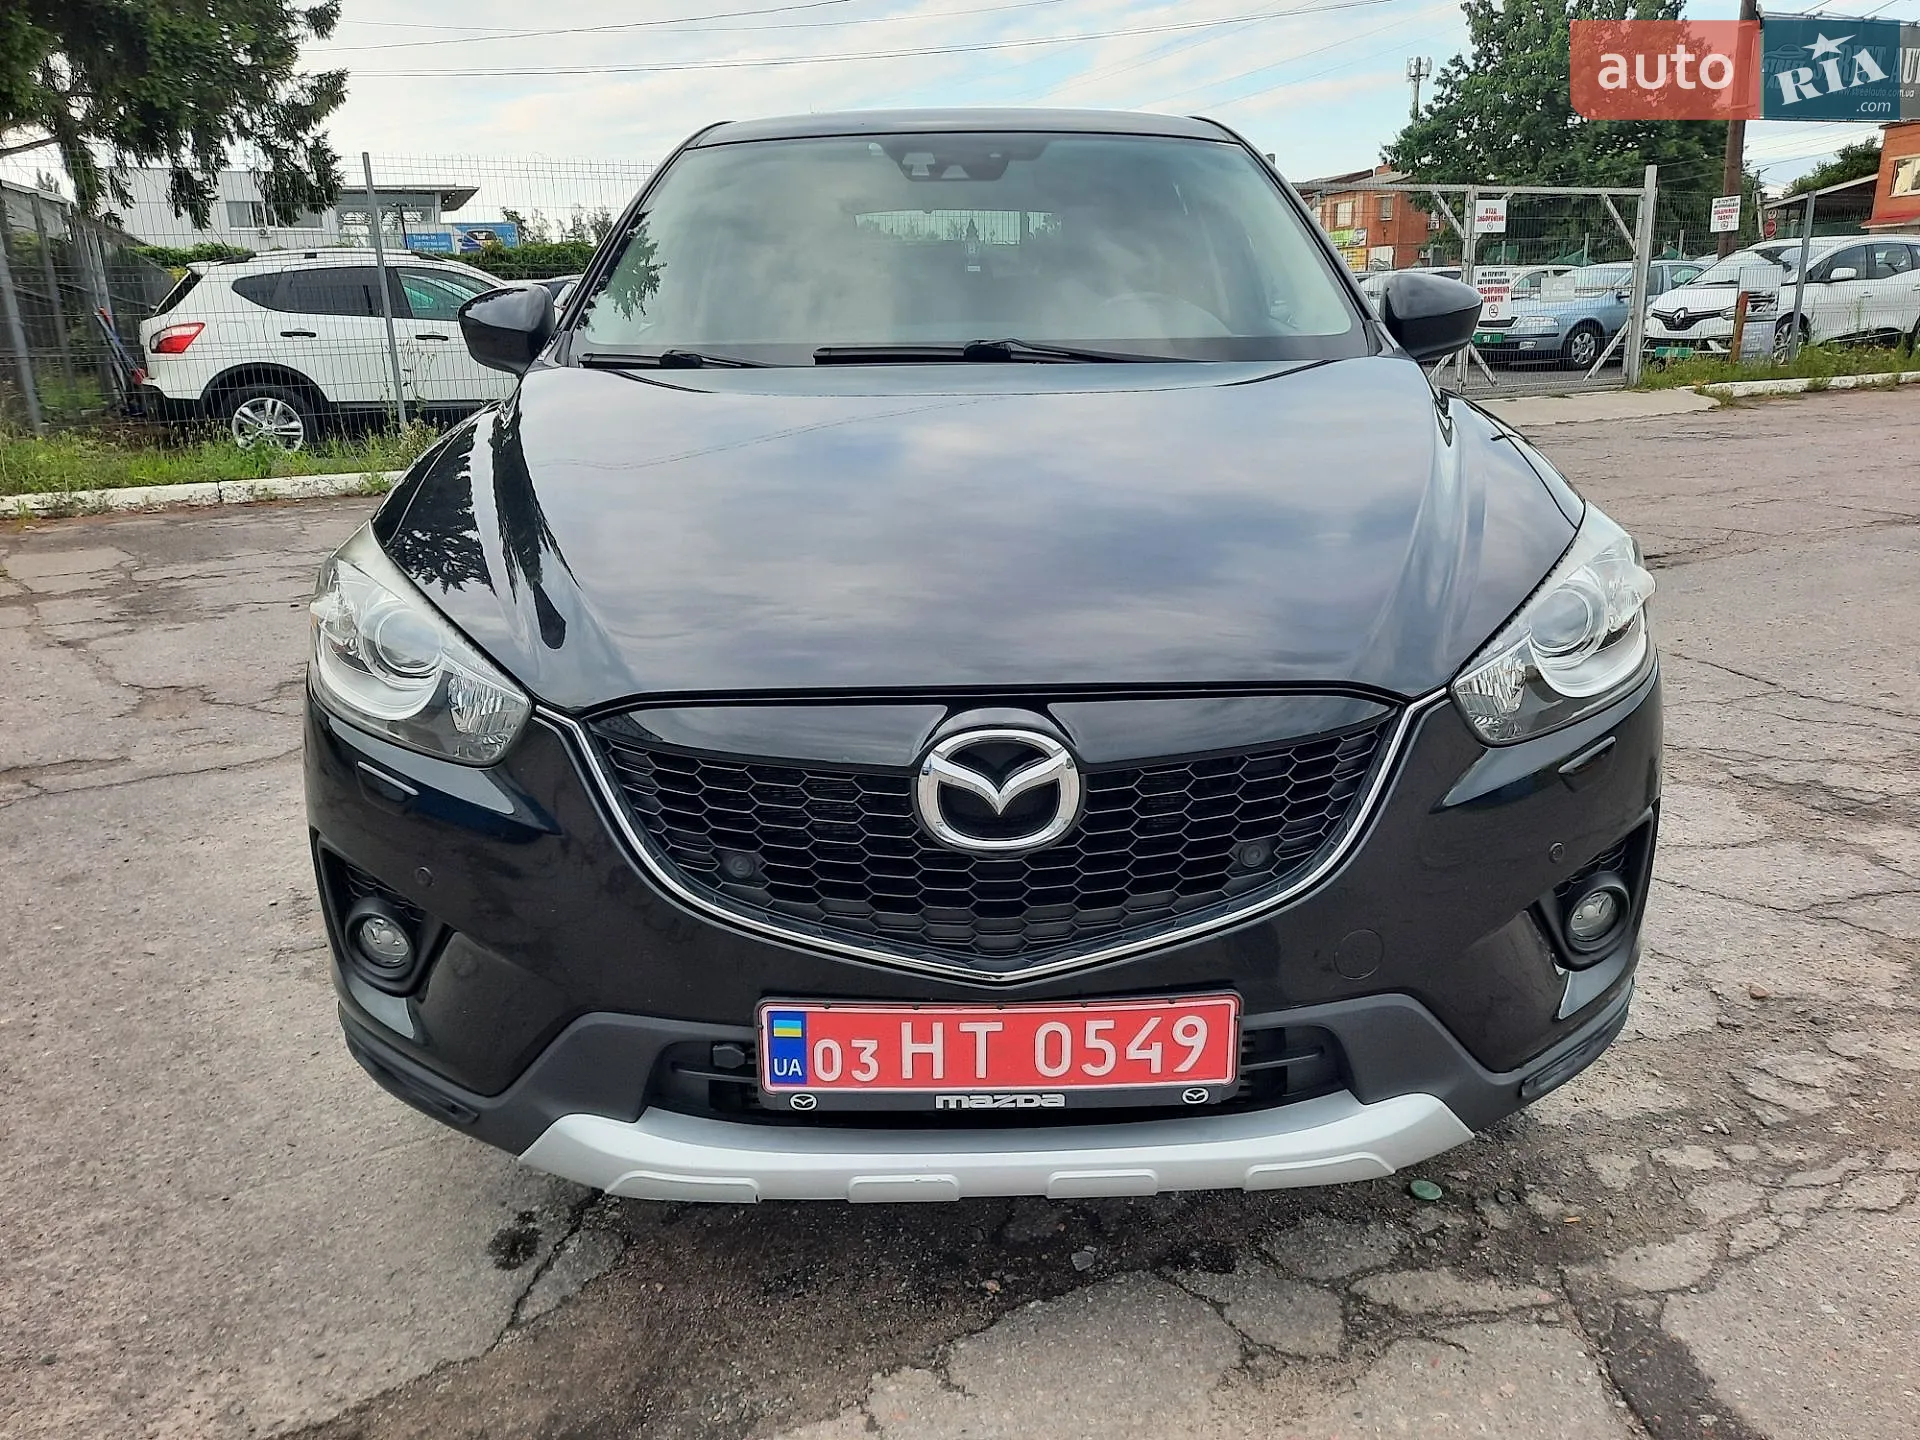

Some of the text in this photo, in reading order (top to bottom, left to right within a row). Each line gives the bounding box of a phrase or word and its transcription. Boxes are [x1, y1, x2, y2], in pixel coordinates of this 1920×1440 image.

[773, 1015, 1209, 1082] UA 03 HT 0549
[935, 1093, 1065, 1110] mazda
